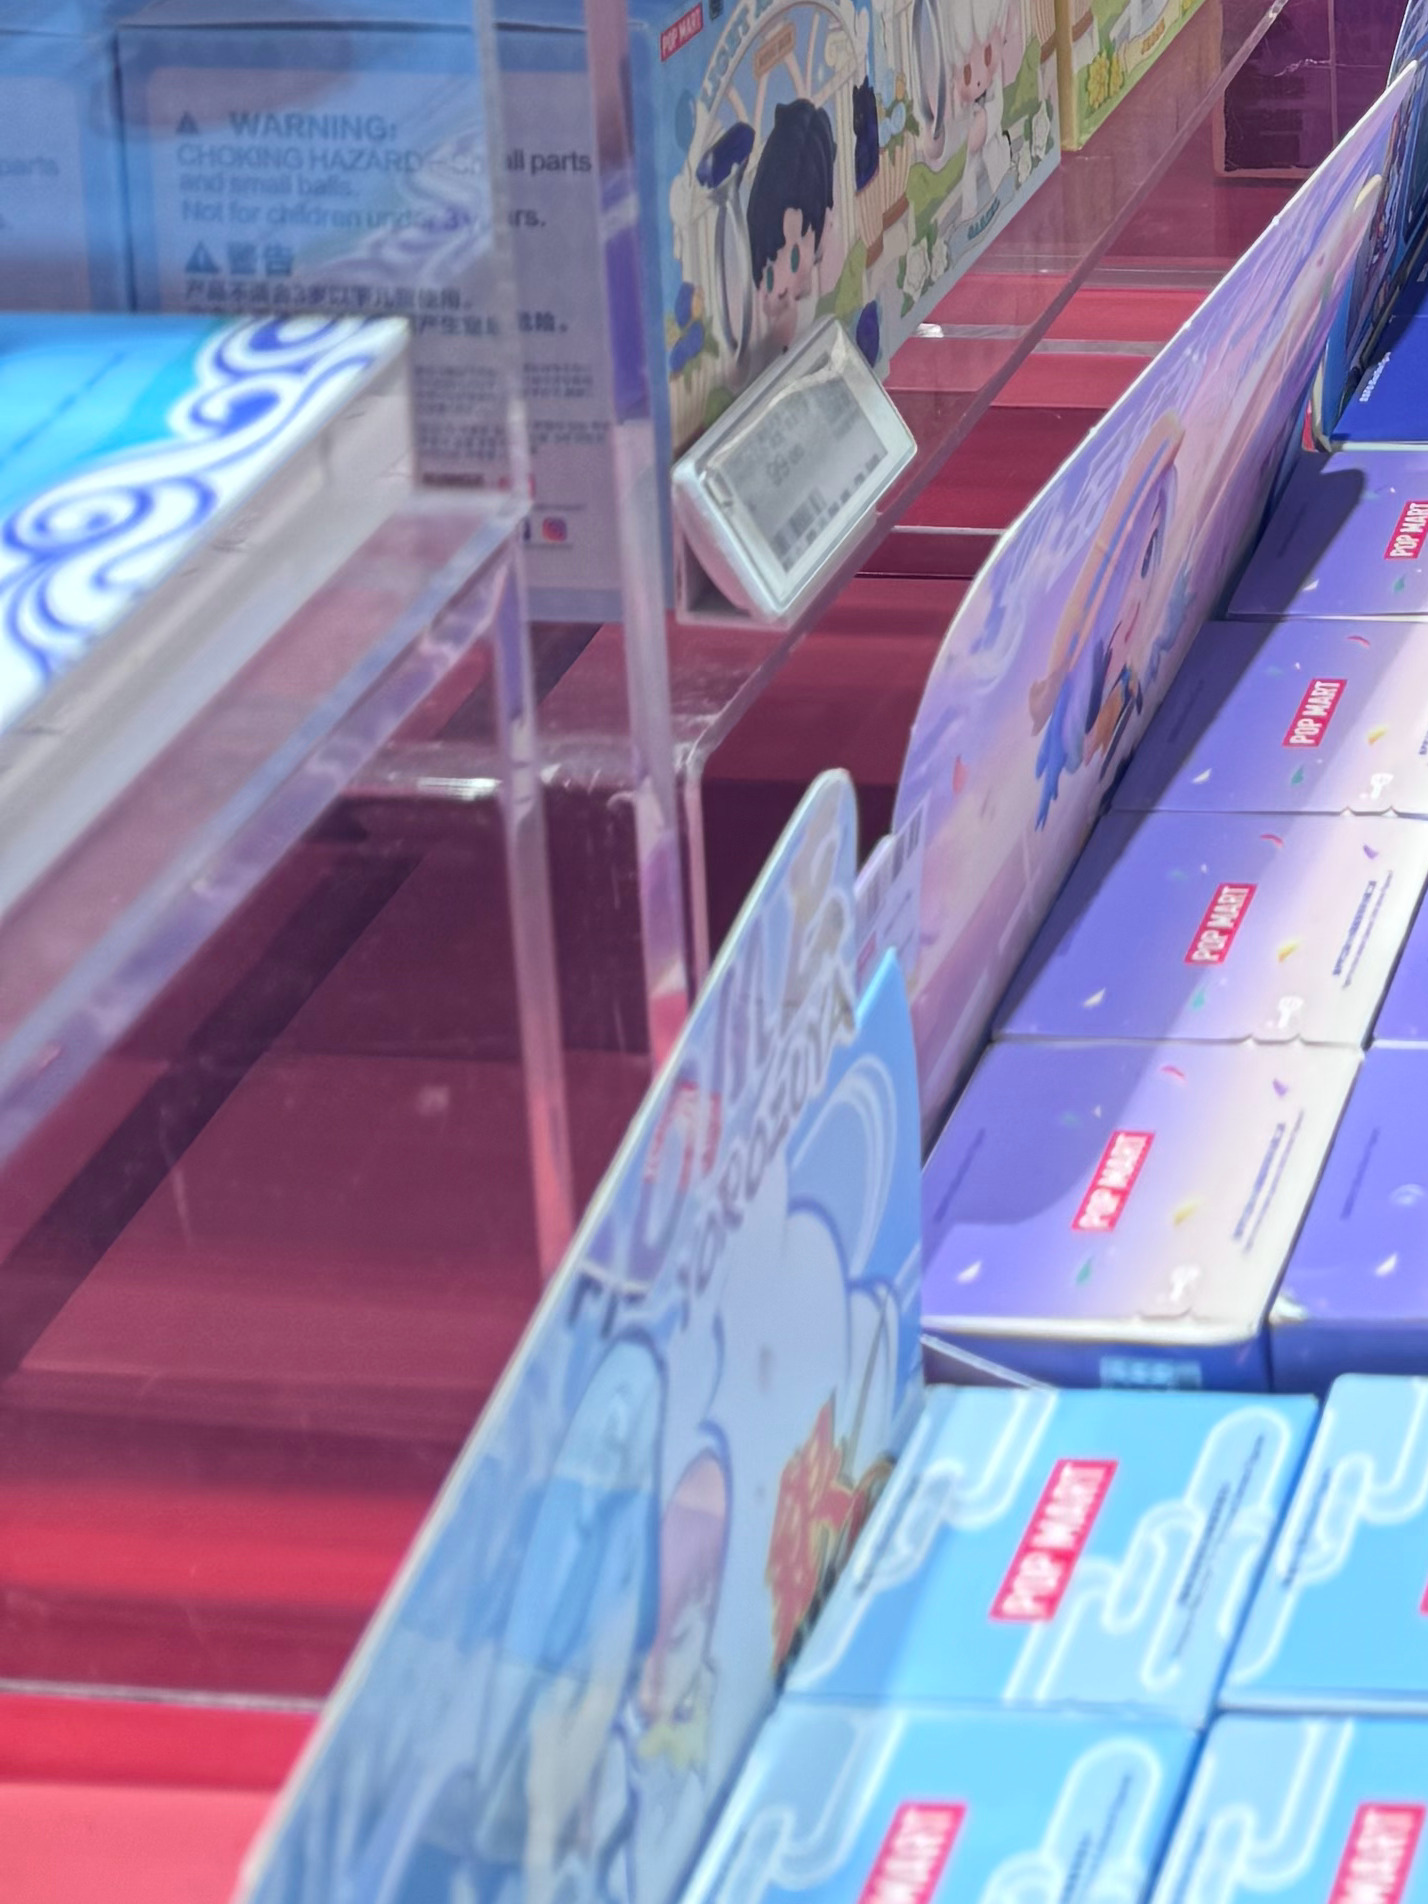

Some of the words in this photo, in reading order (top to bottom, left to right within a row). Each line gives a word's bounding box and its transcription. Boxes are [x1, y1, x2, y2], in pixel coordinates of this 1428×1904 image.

[661, 26, 678, 59] POP
[679, 6, 702, 45] MART
[230, 112, 397, 141] WARNING:
[177, 143, 300, 168] CHOKING
[530, 149, 592, 175] parts
[182, 200, 226, 222] Not
[229, 201, 260, 222] for
[266, 203, 361, 227] children
[1388, 535, 1423, 556] POP
[1298, 682, 1342, 717] MART
[1287, 719, 1327, 744] POP
[1202, 886, 1252, 929] MART
[1188, 931, 1233, 961] POP
[1093, 1133, 1151, 1187] MART
[1077, 1190, 1127, 1226] POP
[1025, 1465, 1110, 1547] MART
[1000, 1552, 1074, 1610] POP
